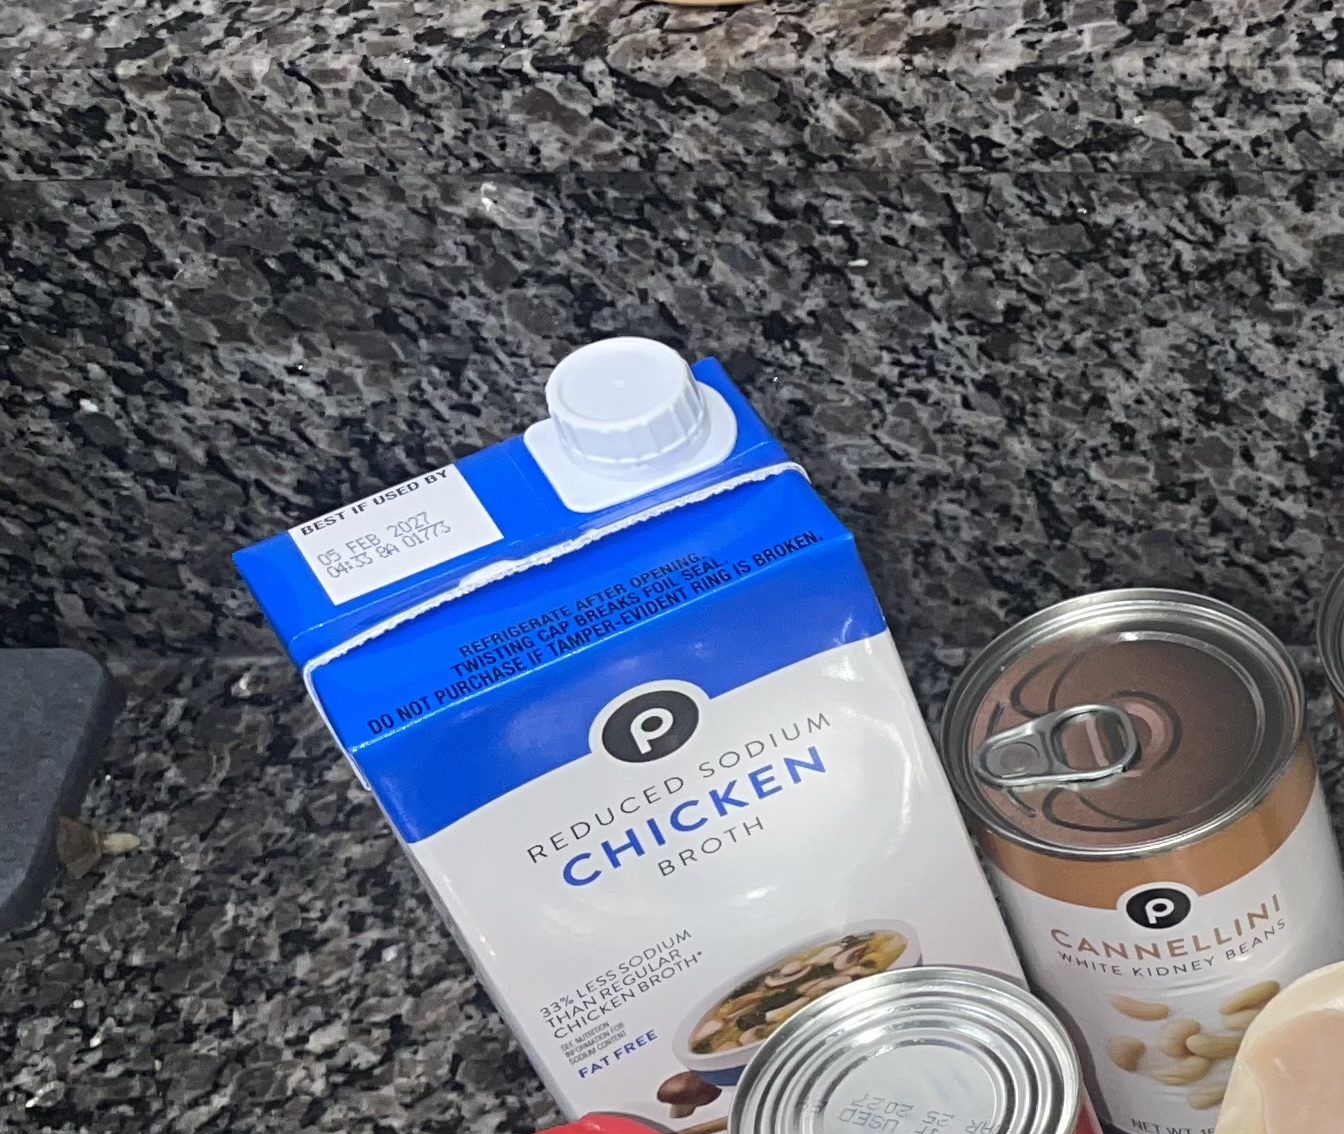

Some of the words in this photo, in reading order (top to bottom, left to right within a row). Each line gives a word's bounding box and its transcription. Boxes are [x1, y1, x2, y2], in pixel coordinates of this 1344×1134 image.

[301, 512, 346, 536] BEST
[352, 502, 368, 514] IF
[373, 482, 419, 505] USED
[424, 469, 447, 484] BY
[317, 548, 342, 566] 05
[346, 533, 381, 555] FEB
[387, 511, 430, 537] 2027
[327, 551, 373, 578] 04:33
[368, 715, 393, 736] DO
[398, 697, 433, 722] NOT
[434, 661, 525, 707] PURCHASE
[528, 648, 545, 664] IF
[545, 590, 688, 656] TAMPER-EVIDENT
[691, 567, 732, 594] RING
[733, 558, 752, 575] IS
[752, 531, 825, 568] BROKEN.
[451, 637, 536, 677] TWISTING
[537, 620, 570, 644] CAP
[573, 593, 642, 627] BREAKS
[642, 577, 682, 601] FOIL
[681, 558, 731, 583] SEAL.
[457, 605, 571, 659] REFRIGERATE
[576, 582, 625, 614] AFTER
[526, 776, 685, 864] REDUCED
[698, 711, 831, 778] SODIUM
[562, 746, 827, 887] CHICKEN
[657, 815, 764, 878] BROTH
[1050, 893, 1283, 961] CANNELLINI
[1056, 950, 1123, 978] WHITE
[1133, 954, 1216, 978] KIDNEY
[1225, 918, 1287, 961] BEANS
[539, 994, 575, 1019] 33%
[575, 967, 618, 999] LESS
[618, 928, 692, 975] SODIUM
[545, 992, 597, 1029] THAN
[599, 947, 682, 1007] REGULAR
[553, 988, 638, 1040] CHICKEN
[578, 1057, 612, 1079] FAT
[614, 1028, 658, 1060] FREE
